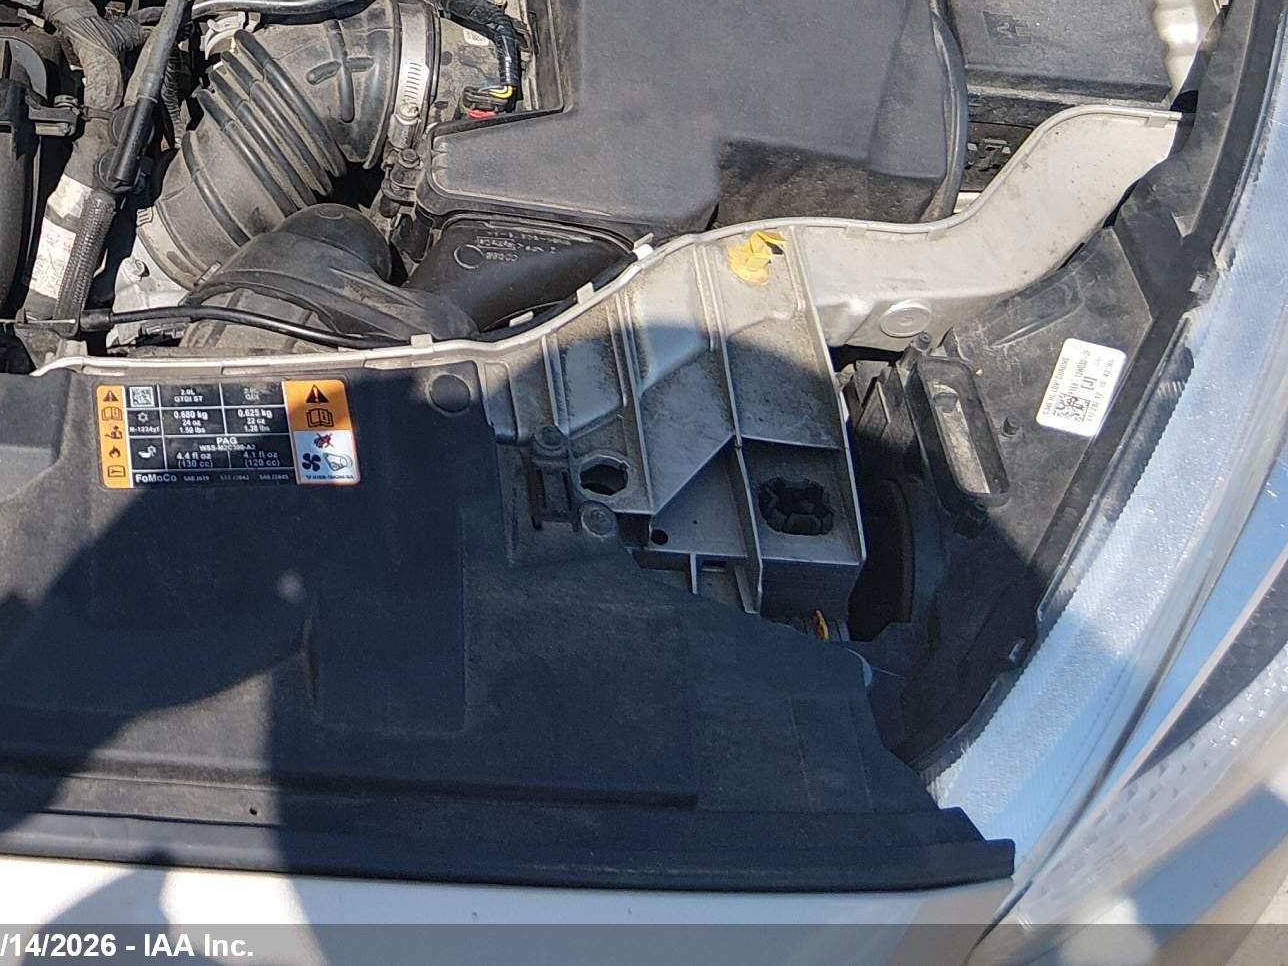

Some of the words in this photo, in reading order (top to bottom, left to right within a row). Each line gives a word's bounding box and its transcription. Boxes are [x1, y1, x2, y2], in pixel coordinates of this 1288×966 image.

[173, 410, 196, 420] 0.680
[197, 410, 209, 421] kg
[237, 408, 260, 418] 0.625
[261, 409, 273, 419] kg
[182, 419, 192, 427] 24
[246, 417, 256, 425] 22
[194, 426, 206, 434] lbs
[259, 424, 271, 432] lbs
[215, 436, 238, 446] PAG
[176, 451, 190, 460] 4.4
[191, 451, 199, 460] fl
[200, 452, 212, 460] oz
[242, 450, 257, 459] 4.1
[258, 451, 266, 459] fl
[267, 451, 279, 459] oz
[177, 459, 197, 469] (130
[199, 459, 214, 468] cc)
[244, 458, 264, 468] (120
[266, 458, 280, 467] cc)
[135, 473, 177, 483] FoMoCo
